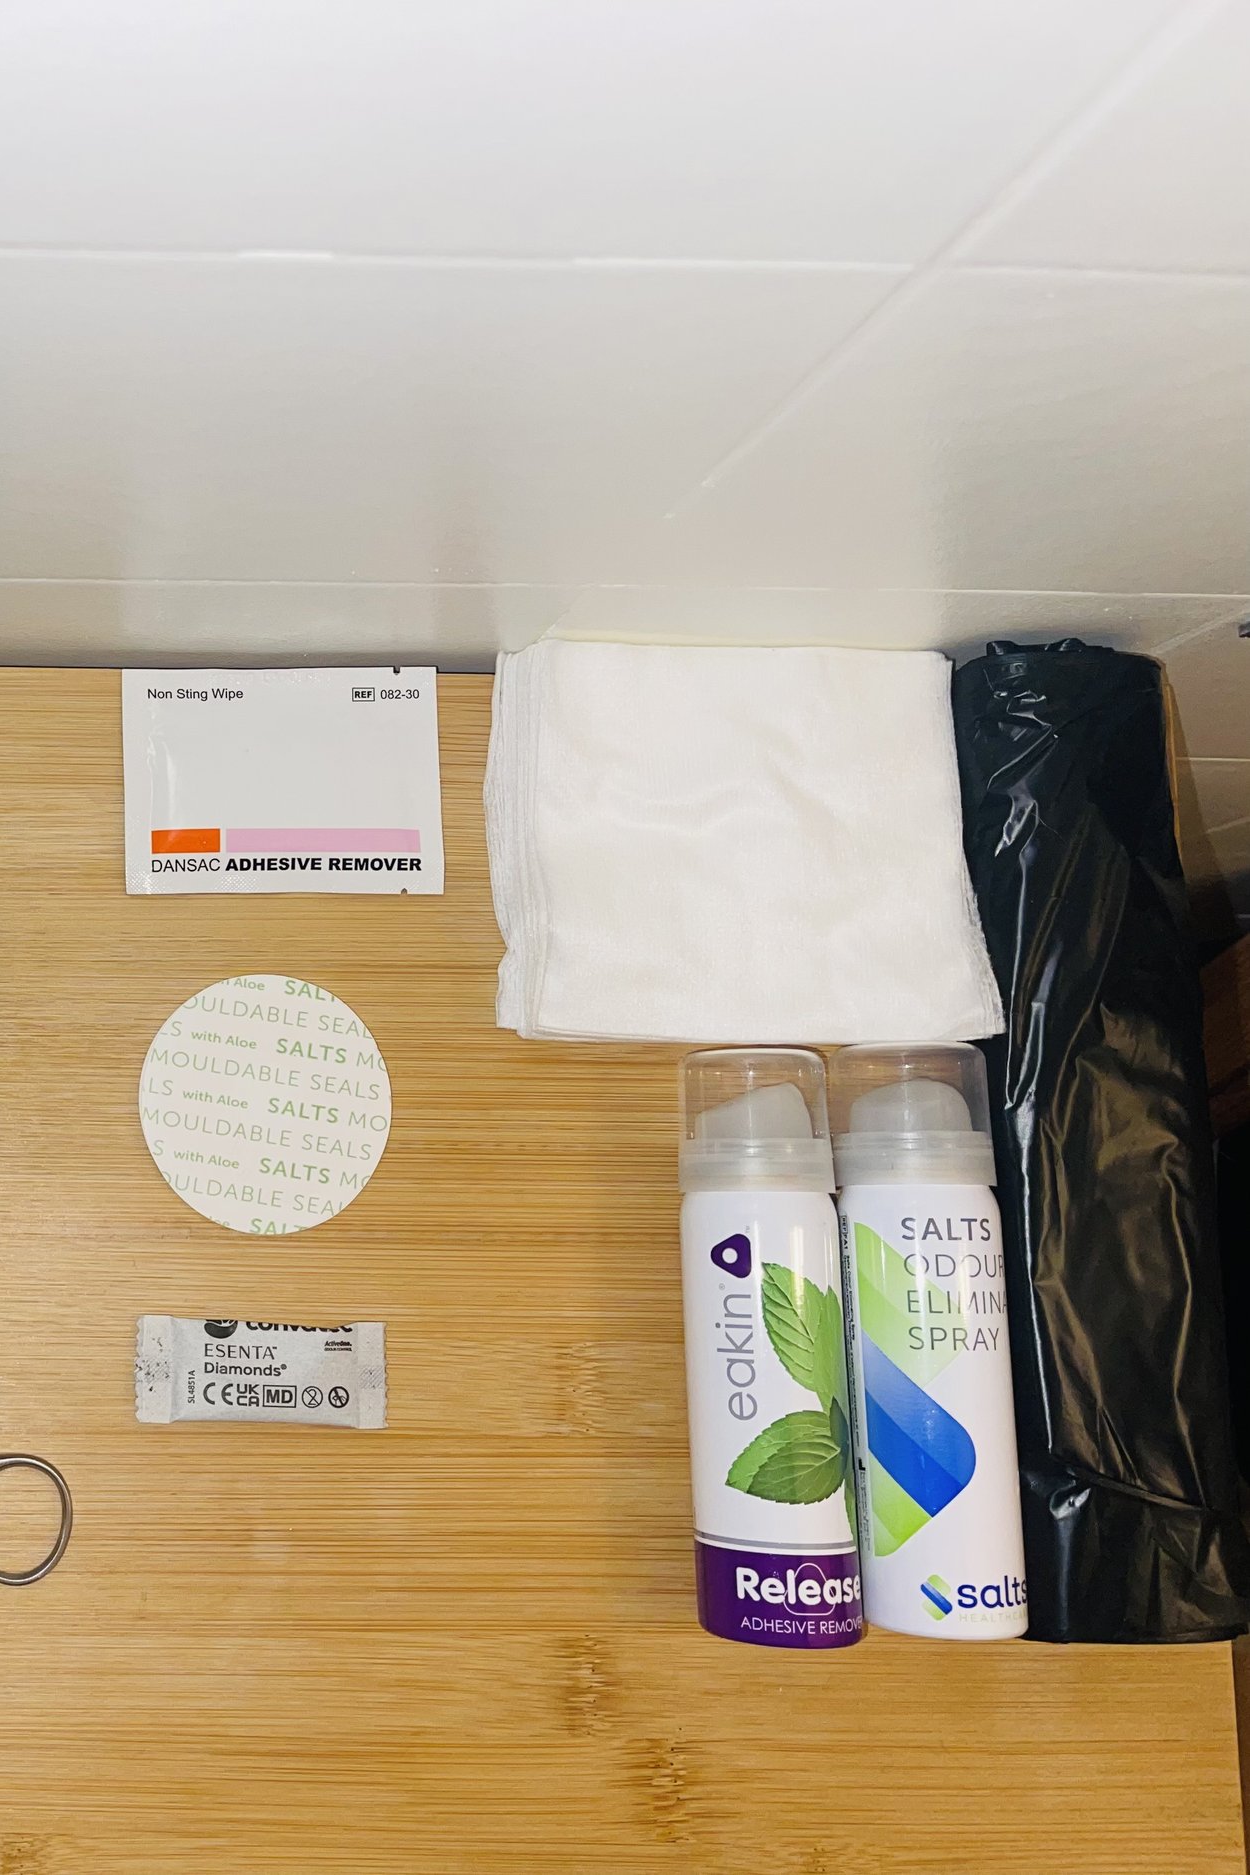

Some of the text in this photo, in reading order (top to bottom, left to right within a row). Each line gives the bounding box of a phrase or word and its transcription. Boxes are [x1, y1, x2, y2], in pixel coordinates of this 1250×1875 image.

[147, 688, 244, 702] Non Sting Wipe
[354, 689, 420, 700] REF 082-30
[152, 857, 422, 873] DANSAC ADHESIVE REMOVER
[233, 977, 266, 991] Aloe
[284, 980, 335, 1003] SAL
[190, 1031, 222, 1044] with
[225, 1035, 258, 1050] Aloe
[276, 1038, 348, 1064] SALTS
[150, 1048, 381, 1101] MOULDABLE SEALS
[182, 1090, 213, 1103] with
[216, 1095, 249, 1109] Aloe
[267, 1097, 340, 1124] SALTS
[142, 1106, 372, 1161] MOULDABLE SEALS
[173, 1150, 204, 1164] with
[207, 1155, 240, 1170] Aloe
[259, 1157, 331, 1184] SALTS
[901, 1217, 991, 1242] SALTS
[903, 1253, 1005, 1278] ODOUR
[908, 1326, 1000, 1351] SPRAY
[187, 1369, 196, 1404] SL4851A
[236, 1383, 260, 1395] UK
[265, 1389, 294, 1404] MD
[736, 1566, 862, 1606] Release
[957, 1575, 1027, 1609] salts
[740, 1616, 816, 1635] ADHESIVE
